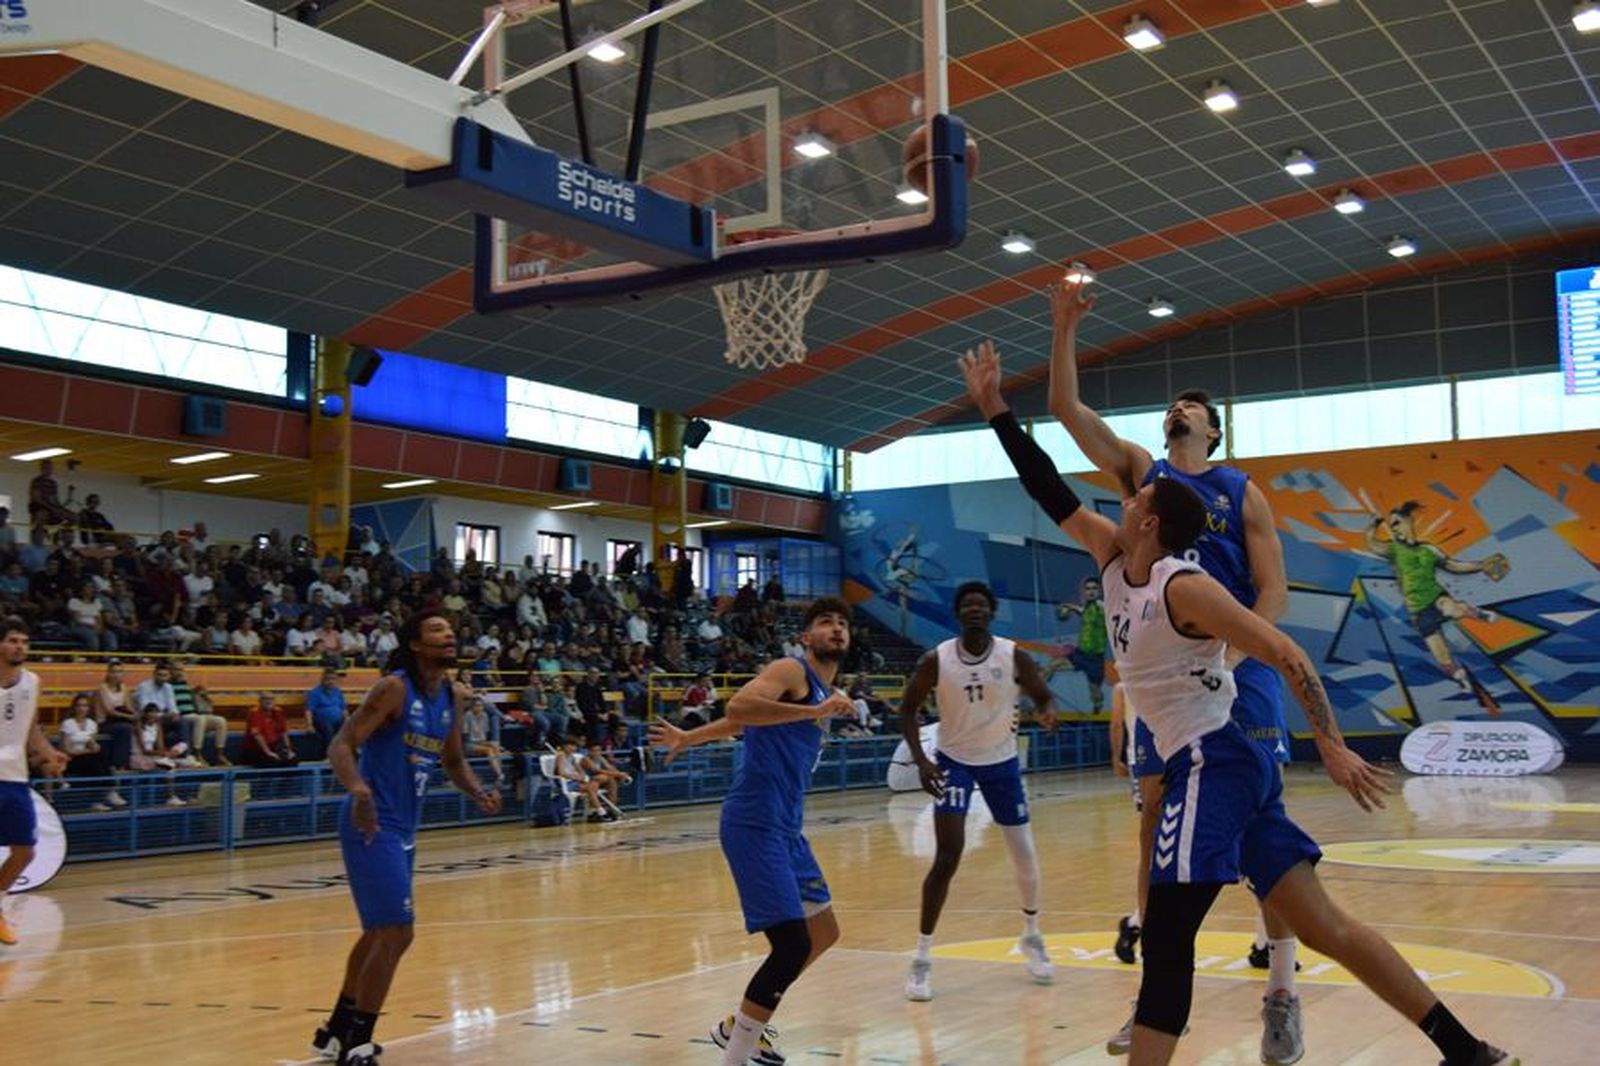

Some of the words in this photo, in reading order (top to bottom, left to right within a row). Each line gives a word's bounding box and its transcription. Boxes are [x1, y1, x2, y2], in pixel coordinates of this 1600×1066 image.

[558, 161, 636, 204] Schelde
[558, 181, 636, 222] Sports
[1112, 614, 1131, 653] 14
[963, 684, 985, 703] 11
[1457, 748, 1530, 763] ZAMORA
[947, 785, 966, 808] 11
